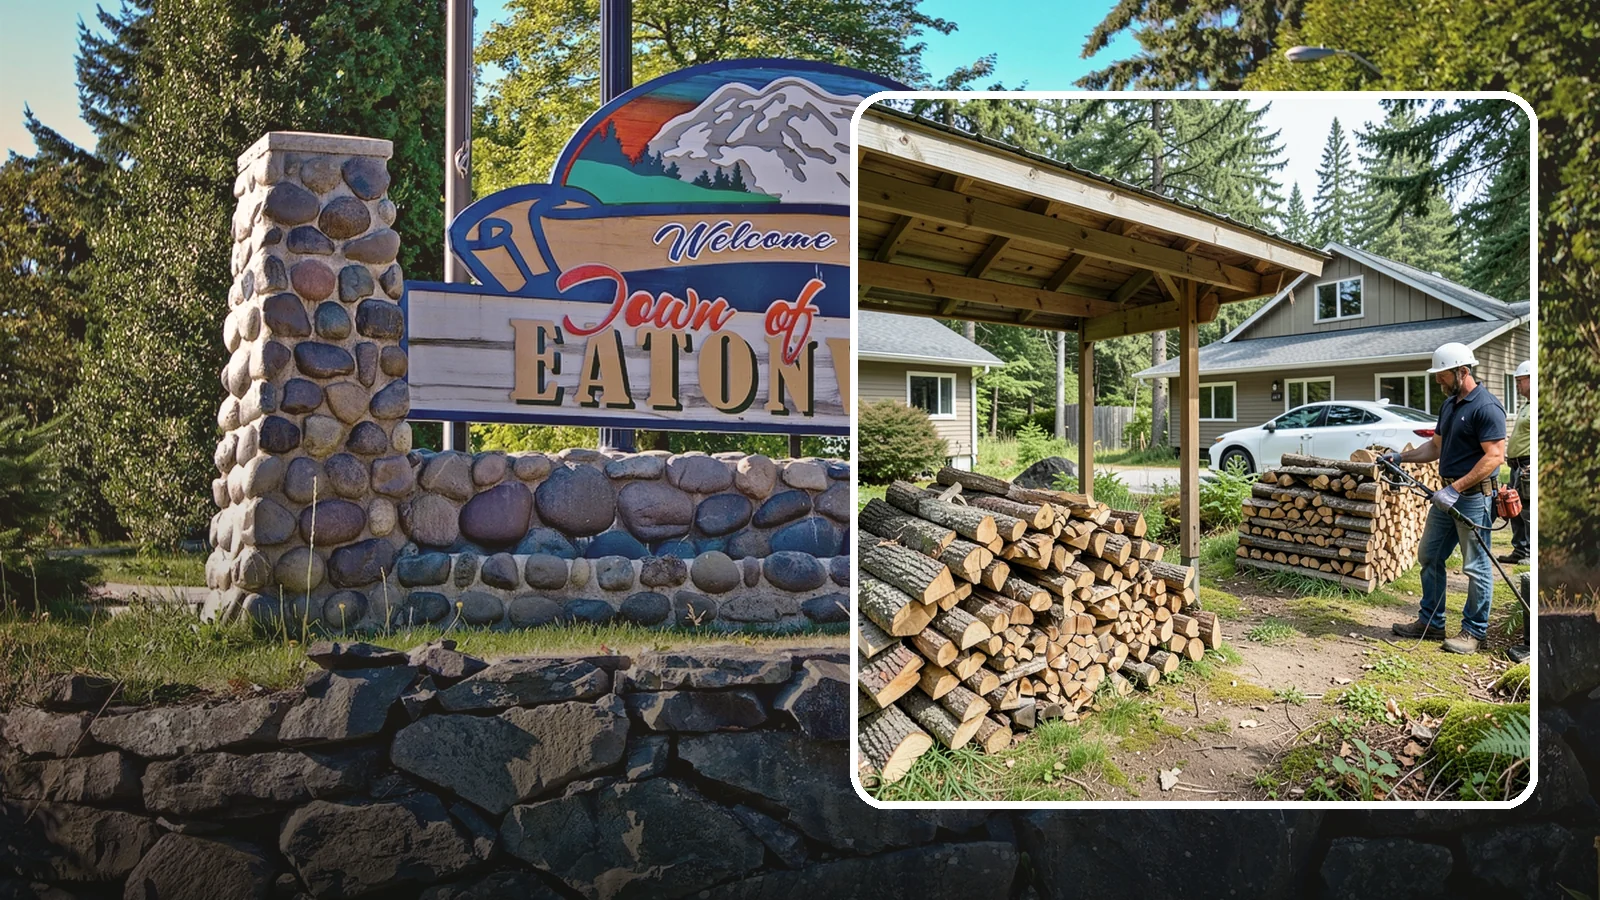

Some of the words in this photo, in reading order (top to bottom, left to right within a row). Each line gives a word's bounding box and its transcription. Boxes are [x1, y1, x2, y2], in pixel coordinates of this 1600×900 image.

[653, 220, 837, 263] Welcome
[556, 263, 736, 336] Town
[764, 278, 826, 366] of
